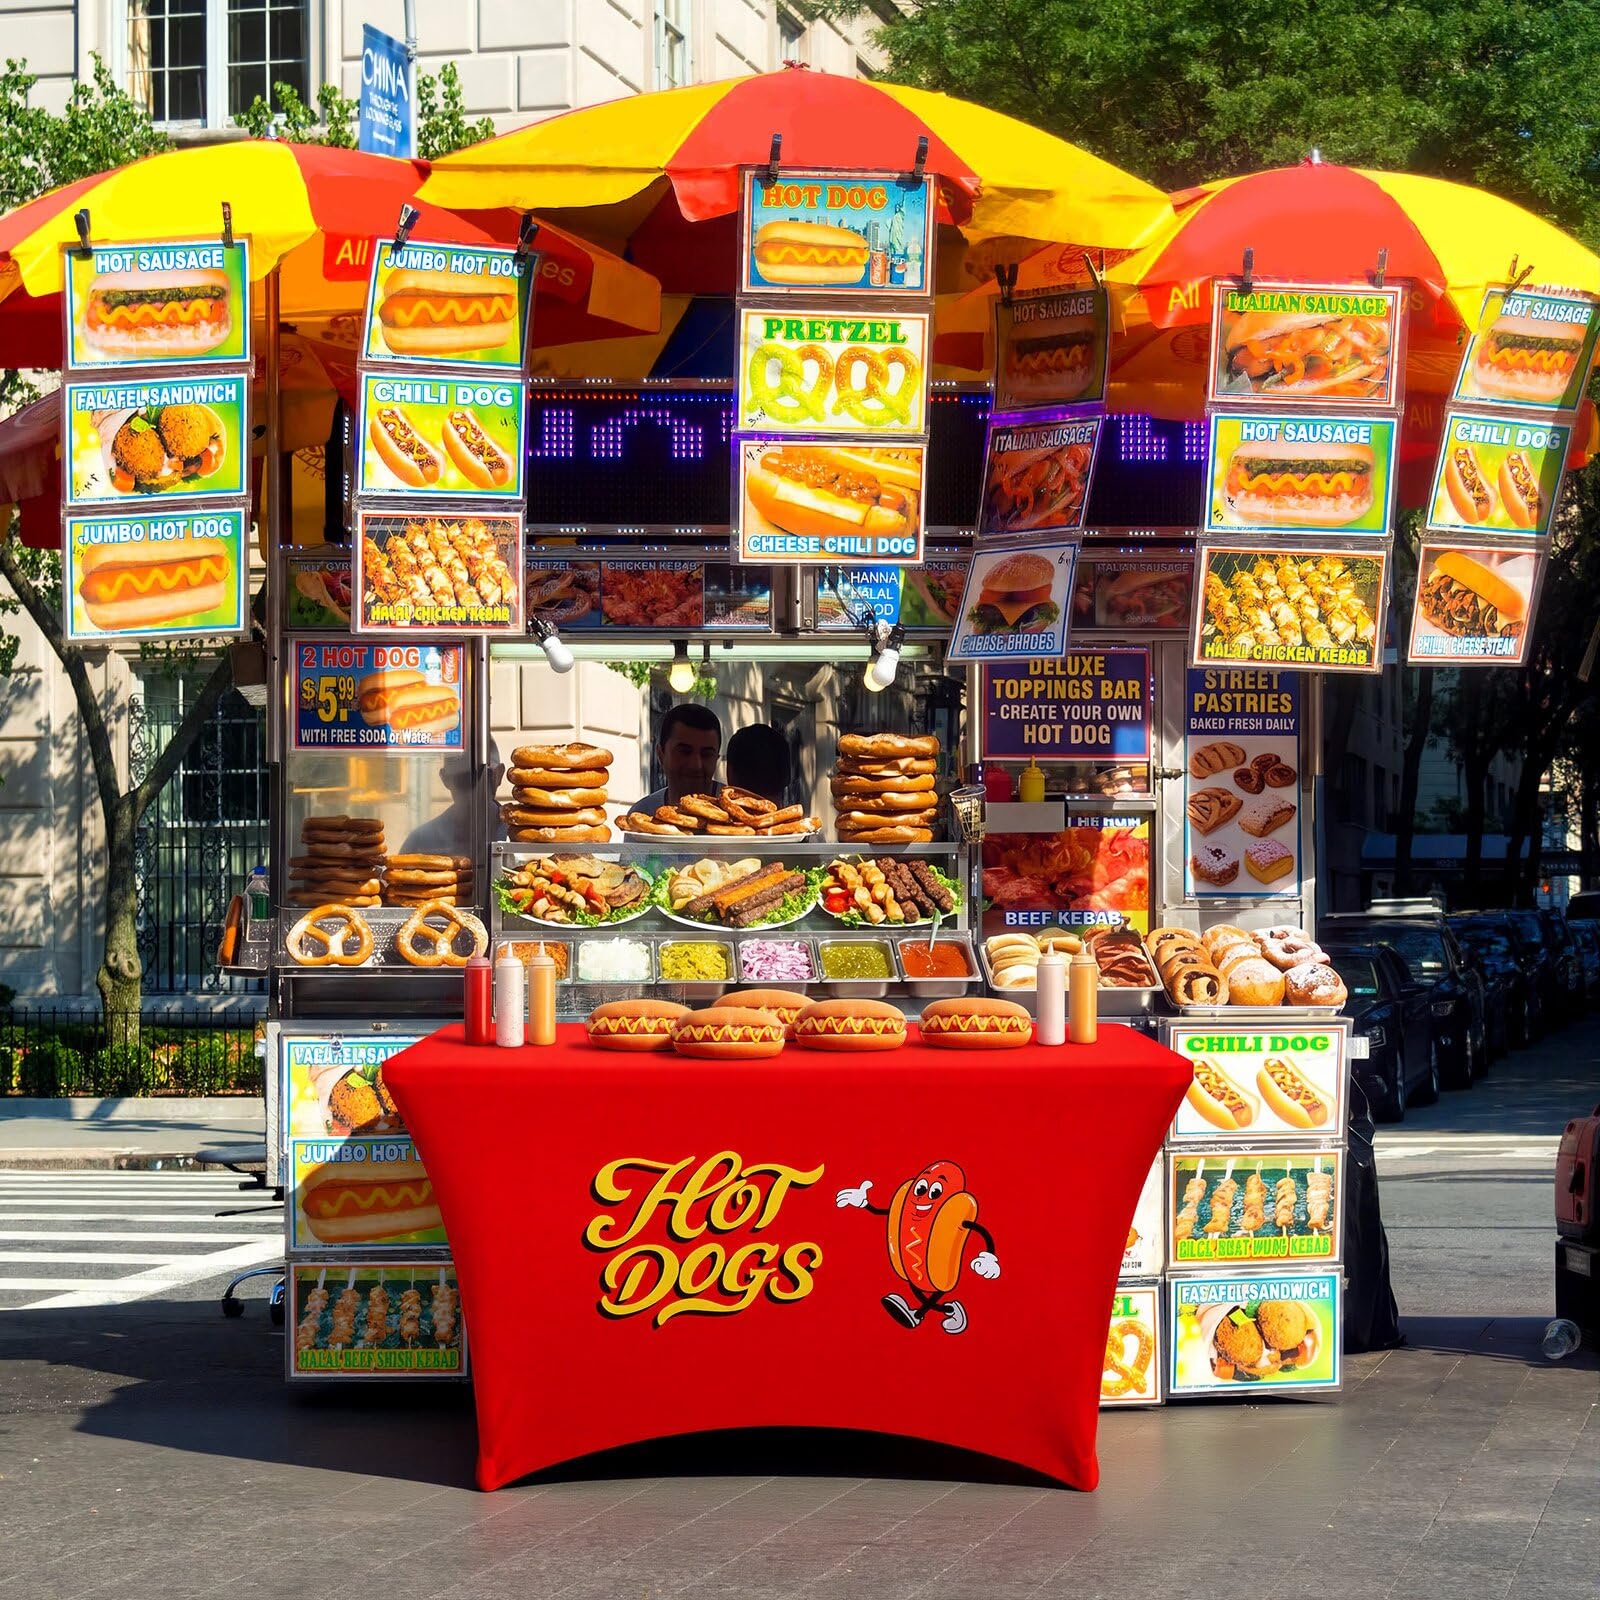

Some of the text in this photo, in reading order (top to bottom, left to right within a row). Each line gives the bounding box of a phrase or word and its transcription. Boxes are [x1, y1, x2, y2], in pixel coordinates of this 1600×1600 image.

[362, 48, 408, 102] CHINA
[762, 185, 888, 211] HOT DOG
[97, 250, 225, 274] HOT SAUSAGE
[336, 240, 369, 266] All
[384, 248, 447, 275] JUMBO
[449, 255, 490, 275] HOT
[489, 260, 527, 280] DOG
[1168, 281, 1200, 312] All
[1227, 292, 1301, 313] ITALIAN
[1303, 296, 1388, 317] SAUSAGE
[1013, 297, 1095, 322] HOT SAUSAGE
[1500, 297, 1592, 325] HOT SAUSAGE
[763, 319, 908, 345] PRETZEL
[77, 384, 237, 410] FALAFEL SANDWICH
[374, 382, 513, 408] CHILI DOG
[994, 432, 1039, 452] ITALIAN
[1039, 426, 1094, 448] SAUSAGE
[1240, 421, 1371, 444] HOT SAUSAGE
[1455, 422, 1560, 449] CHILI DOG
[79, 518, 233, 545] JUMBO HOT DOG
[748, 535, 916, 556] CHEESE CHILI DOG
[607, 561, 698, 572] CHICKEN KEBAB
[850, 571, 900, 584] HANNA
[1139, 563, 1189, 573] SAUSAGE
[413, 604, 468, 622] CHICKEN
[302, 646, 317, 669] 2
[322, 647, 369, 669] HOT
[373, 647, 421, 669] DOG
[1252, 644, 1317, 663] CHICKEN
[1318, 648, 1368, 665] KEBAB
[1029, 655, 1106, 677] DELUXE
[992, 679, 1142, 700] TOPPINGS BAR
[1204, 669, 1281, 690] STREET
[1000, 704, 1058, 720] CREATE
[1062, 704, 1103, 720] YOUR
[1107, 704, 1143, 721] OWN
[1193, 692, 1293, 714] PASTRIES
[1023, 723, 1112, 744] HOT DOG
[1190, 718, 1296, 730] BAKED FRESH DAILY
[301, 728, 327, 744] WITH
[330, 728, 356, 744] FREE
[359, 729, 387, 744] SODA
[388, 732, 401, 744] or
[1005, 911, 1123, 926] BEEF KEBAB
[1186, 1036, 1330, 1053] CHILI DOG
[301, 1144, 367, 1163] JUMBO
[372, 1143, 415, 1162] HOT
[1289, 1235, 1330, 1256] KEBAB
[1248, 1282, 1330, 1303] SANDWICH
